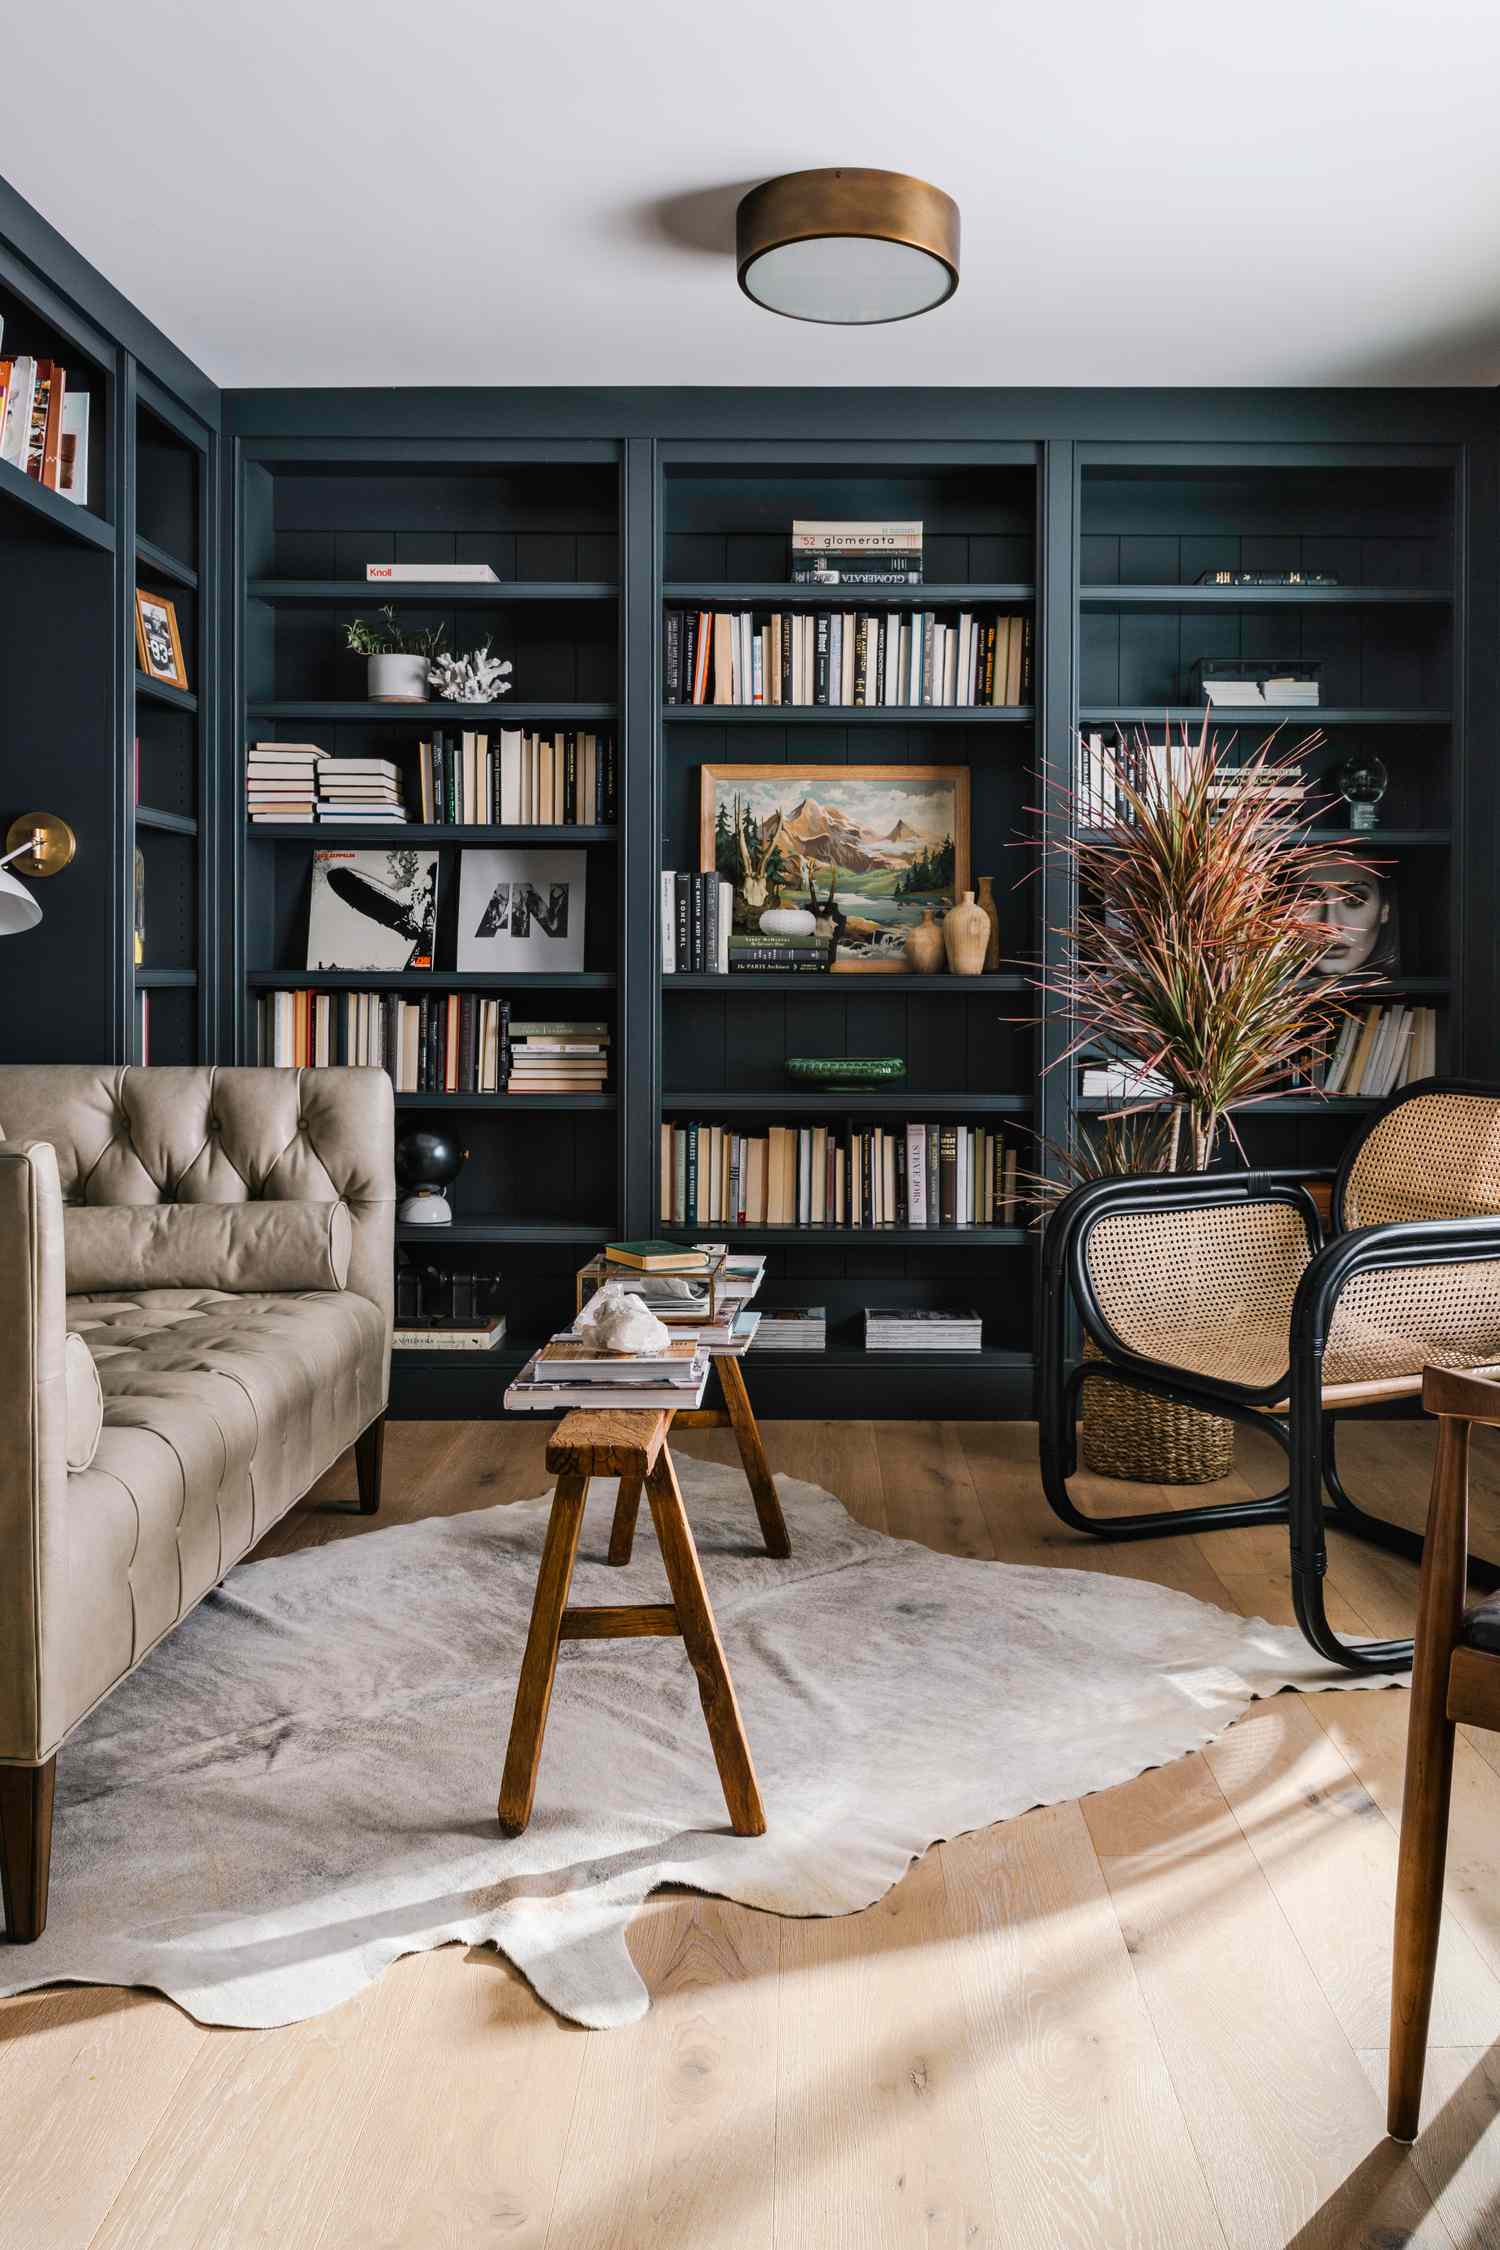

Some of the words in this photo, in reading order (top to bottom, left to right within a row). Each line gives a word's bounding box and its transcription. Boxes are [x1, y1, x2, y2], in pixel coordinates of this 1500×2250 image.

[824, 535, 895, 548] glomerata
[369, 567, 392, 577] Knoll
[841, 574, 905, 584] GLOMERATA
[679, 899, 687, 924] GONE
[679, 927, 687, 948] GIRL
[911, 1144, 921, 1177] STEVE
[911, 1179, 921, 1204] JOBS
